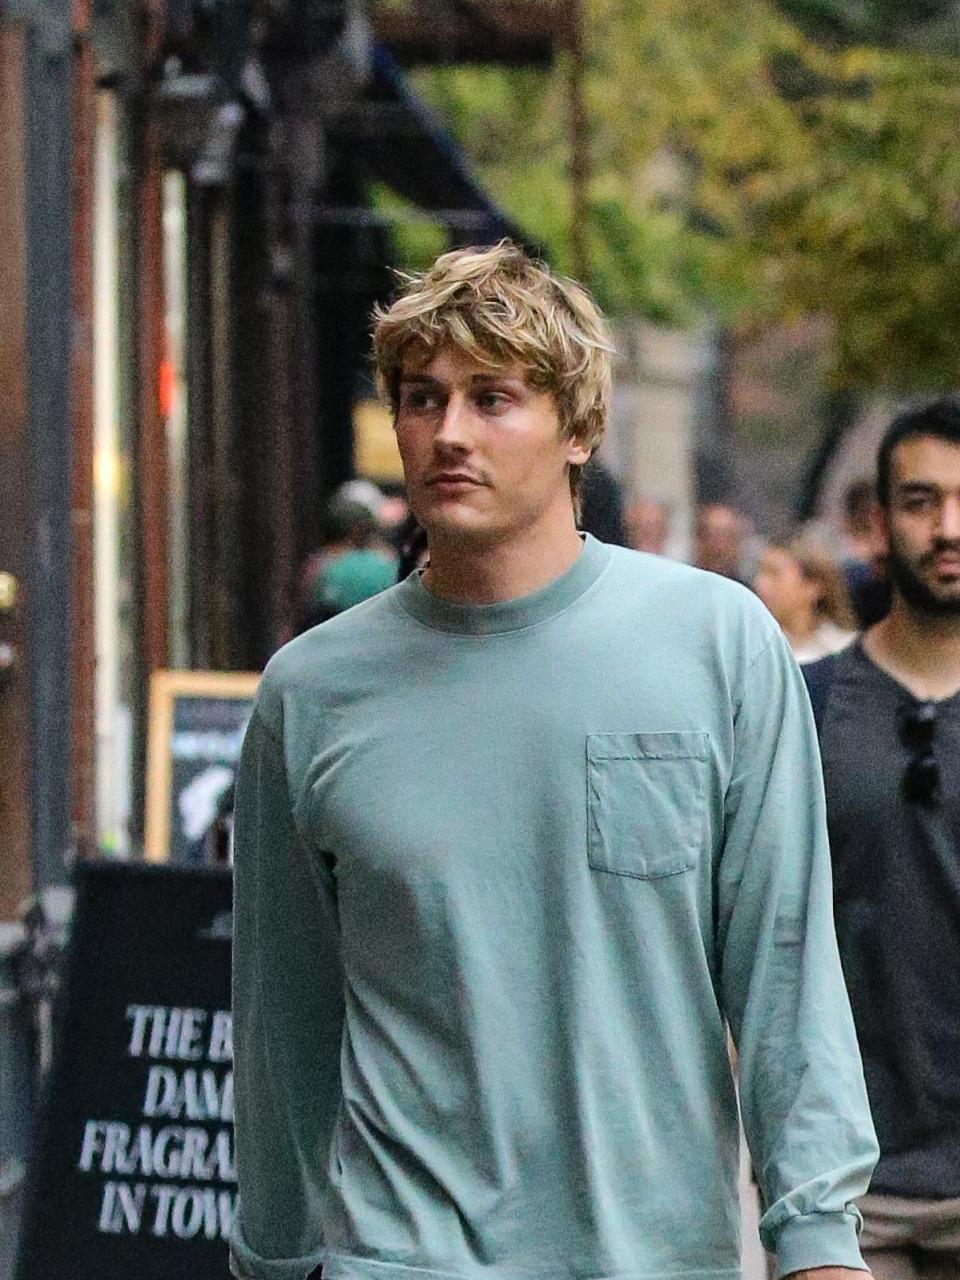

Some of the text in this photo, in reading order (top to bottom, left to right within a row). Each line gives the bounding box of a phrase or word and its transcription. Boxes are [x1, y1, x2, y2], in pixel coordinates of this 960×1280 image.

[126, 1004, 207, 1060] THE
[143, 1065, 233, 1121] DAM
[79, 1120, 237, 1181] FRAGRA
[99, 1180, 239, 1240] IN TOW
